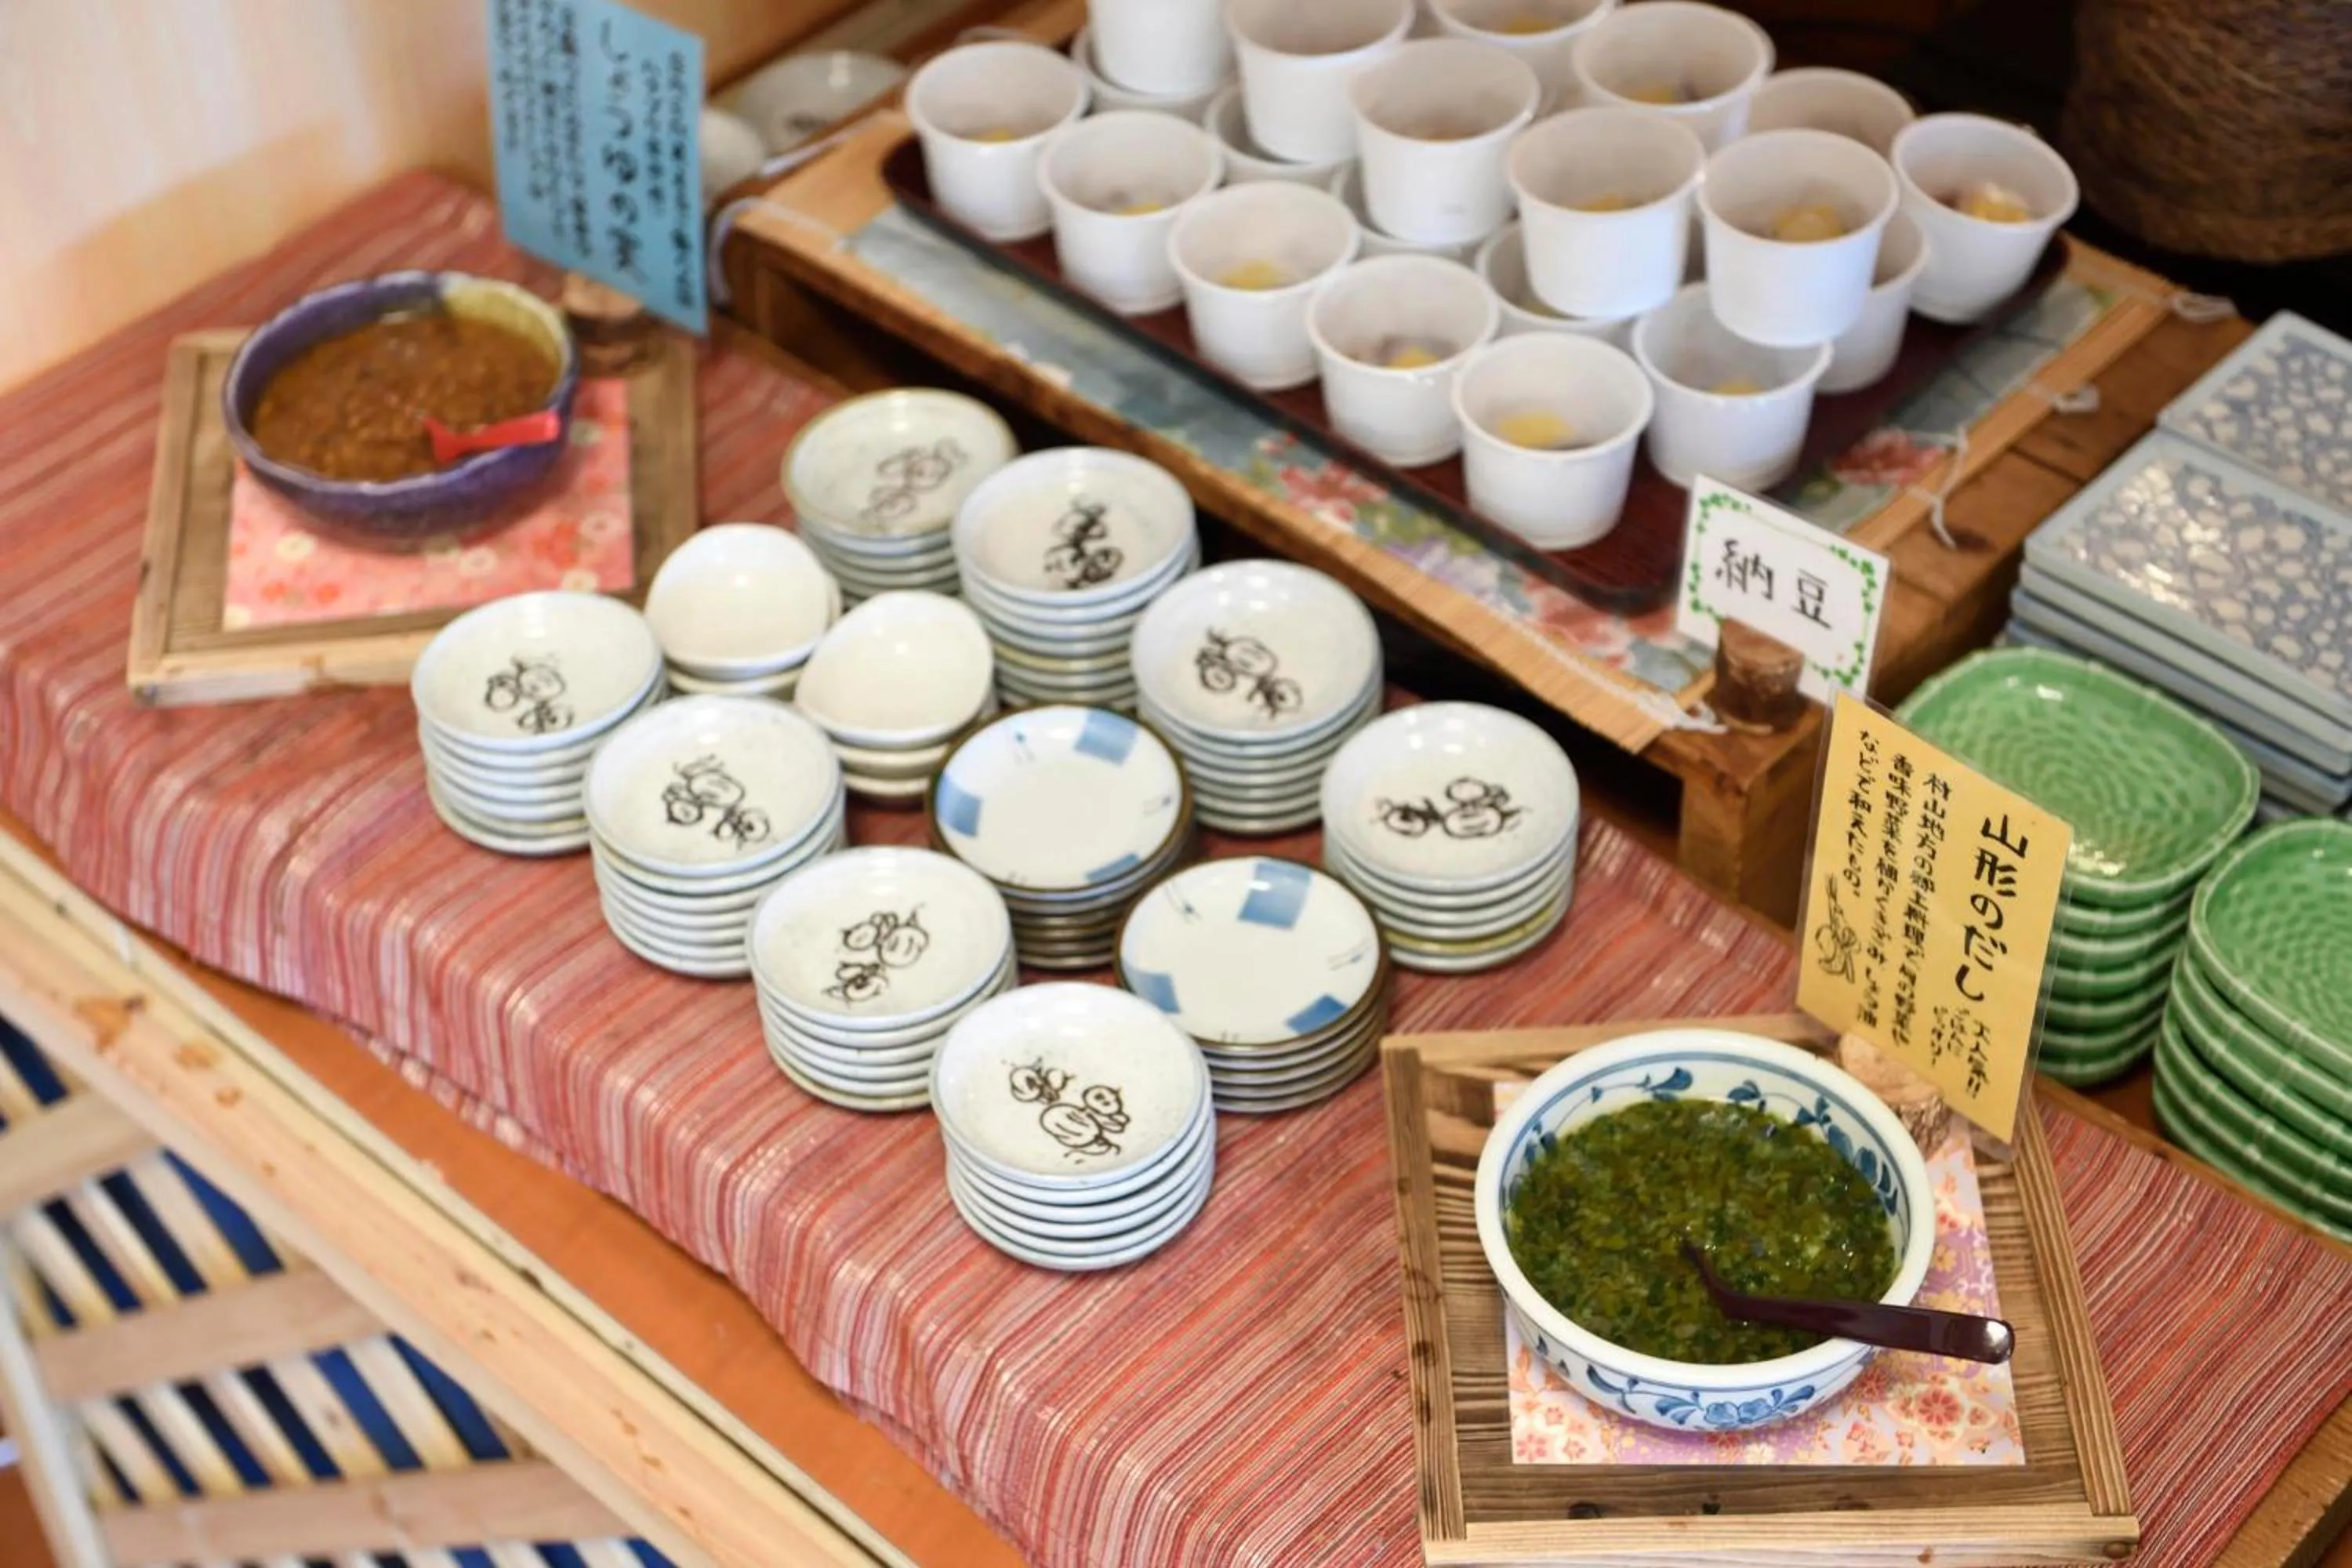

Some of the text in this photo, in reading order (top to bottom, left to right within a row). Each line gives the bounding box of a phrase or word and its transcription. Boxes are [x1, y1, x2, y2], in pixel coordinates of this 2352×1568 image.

[1715, 537, 1832, 630] 納豆
[1955, 813, 2029, 1002] 山形のだし
